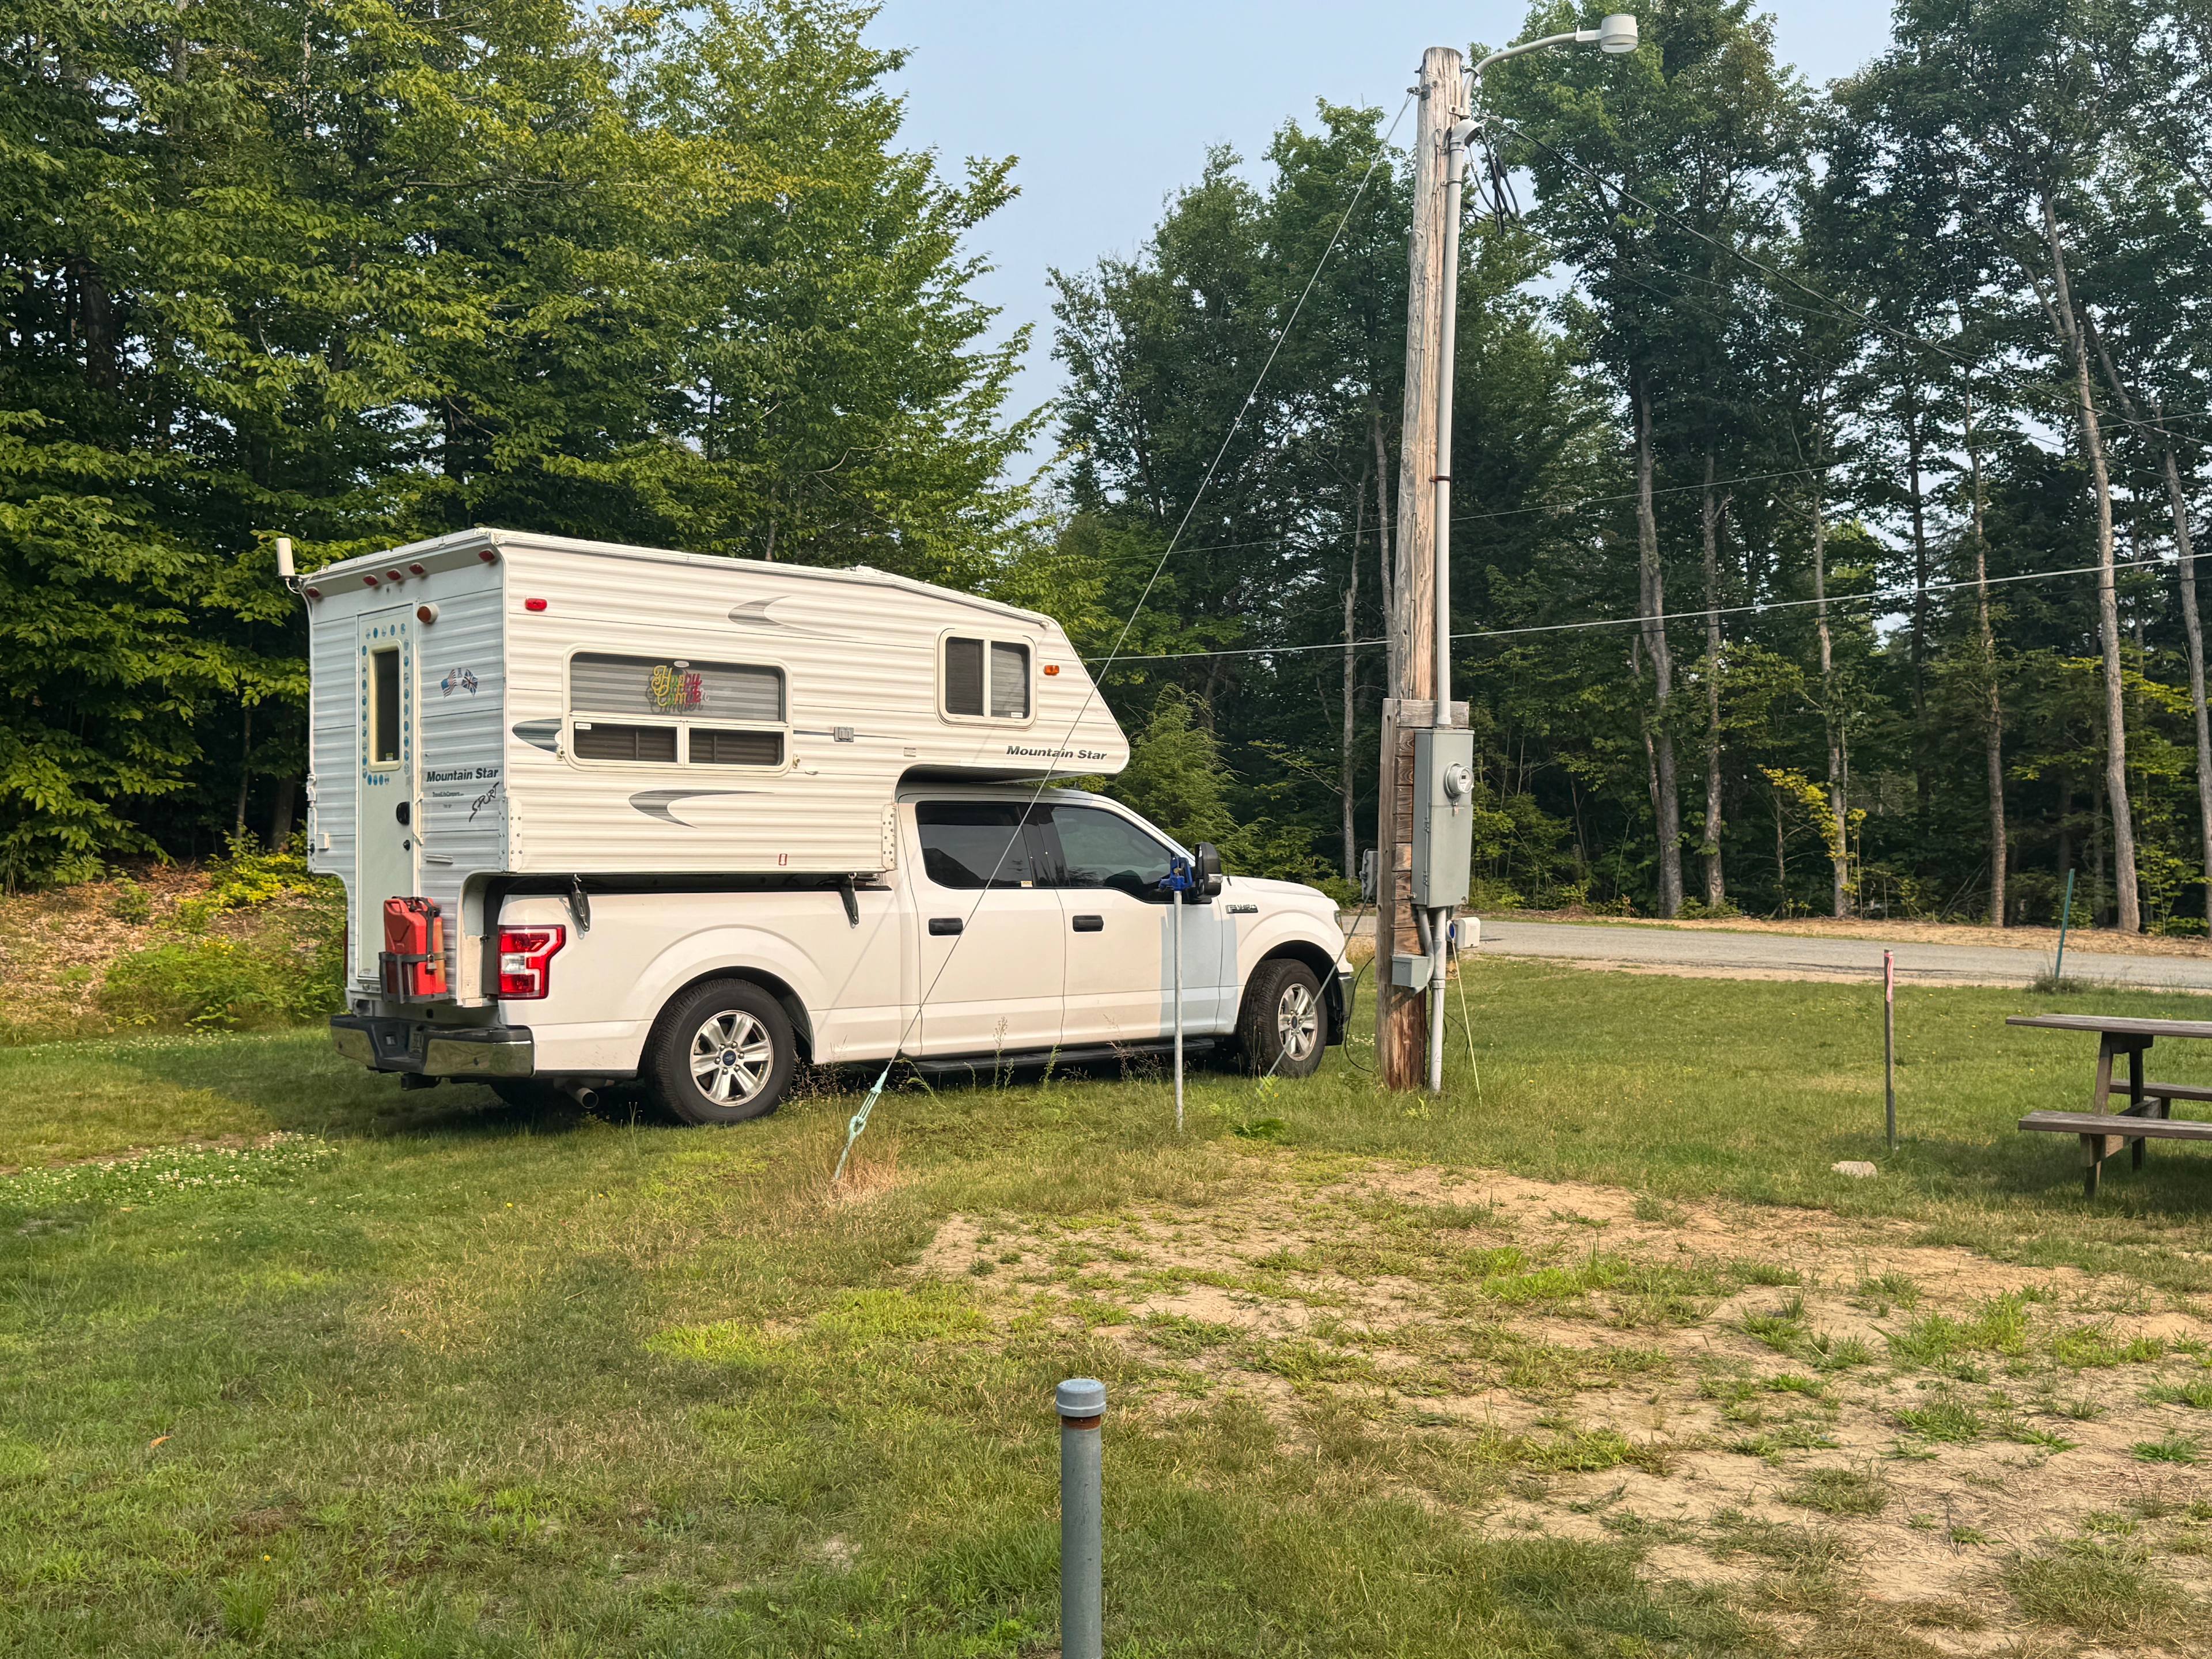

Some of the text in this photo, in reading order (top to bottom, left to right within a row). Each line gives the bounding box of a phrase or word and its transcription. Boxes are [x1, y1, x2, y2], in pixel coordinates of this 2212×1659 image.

[652, 665, 703, 696] Happy
[1006, 745, 1107, 760] Mountain Star
[426, 767, 499, 782] Mountain Star
